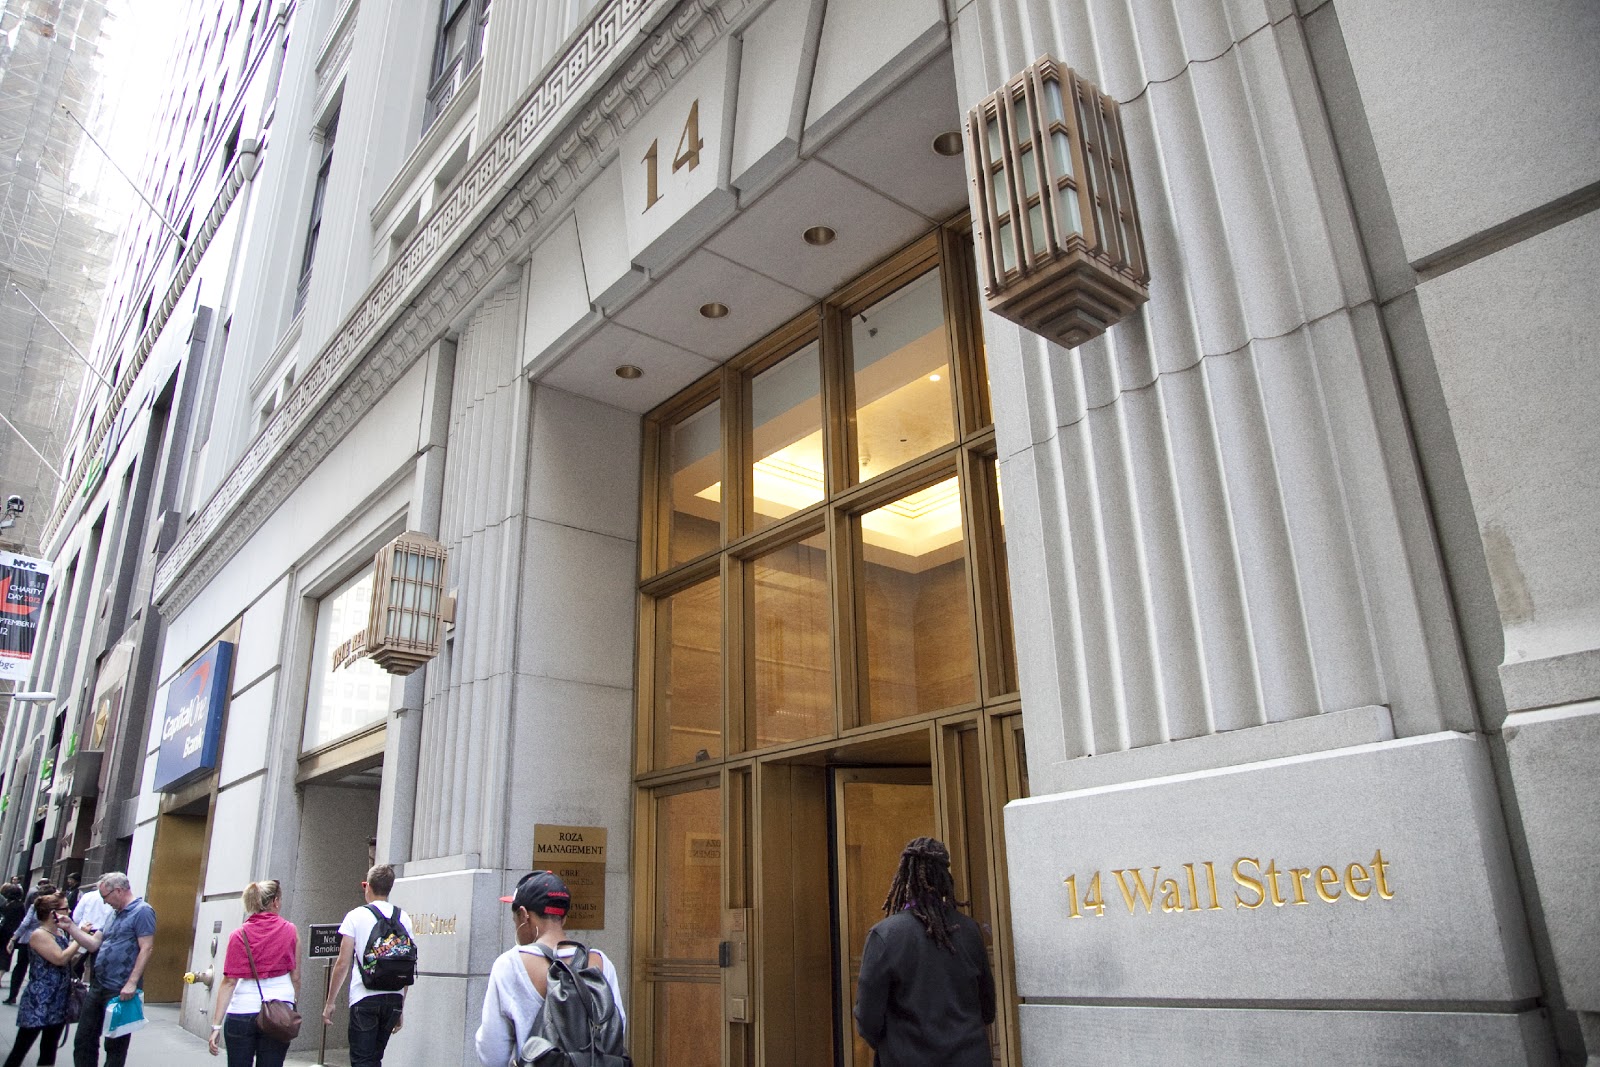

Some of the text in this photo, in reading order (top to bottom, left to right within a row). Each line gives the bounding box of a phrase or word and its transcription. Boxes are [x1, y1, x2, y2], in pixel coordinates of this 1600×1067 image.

[640, 98, 704, 215] 14
[13, 559, 37, 570] NYC
[9, 584, 43, 596] CHARITY
[7, 592, 24, 601] DAY
[0, 617, 29, 628] PTEMBER
[182, 728, 204, 759] Bank
[559, 832, 583, 842] ROZA
[537, 844, 604, 855] MANAGEMENT
[1063, 848, 1395, 919] 14 Wall Street
[429, 912, 457, 936] Street
[323, 935, 336, 943] Not
[314, 945, 340, 954] Smokin
